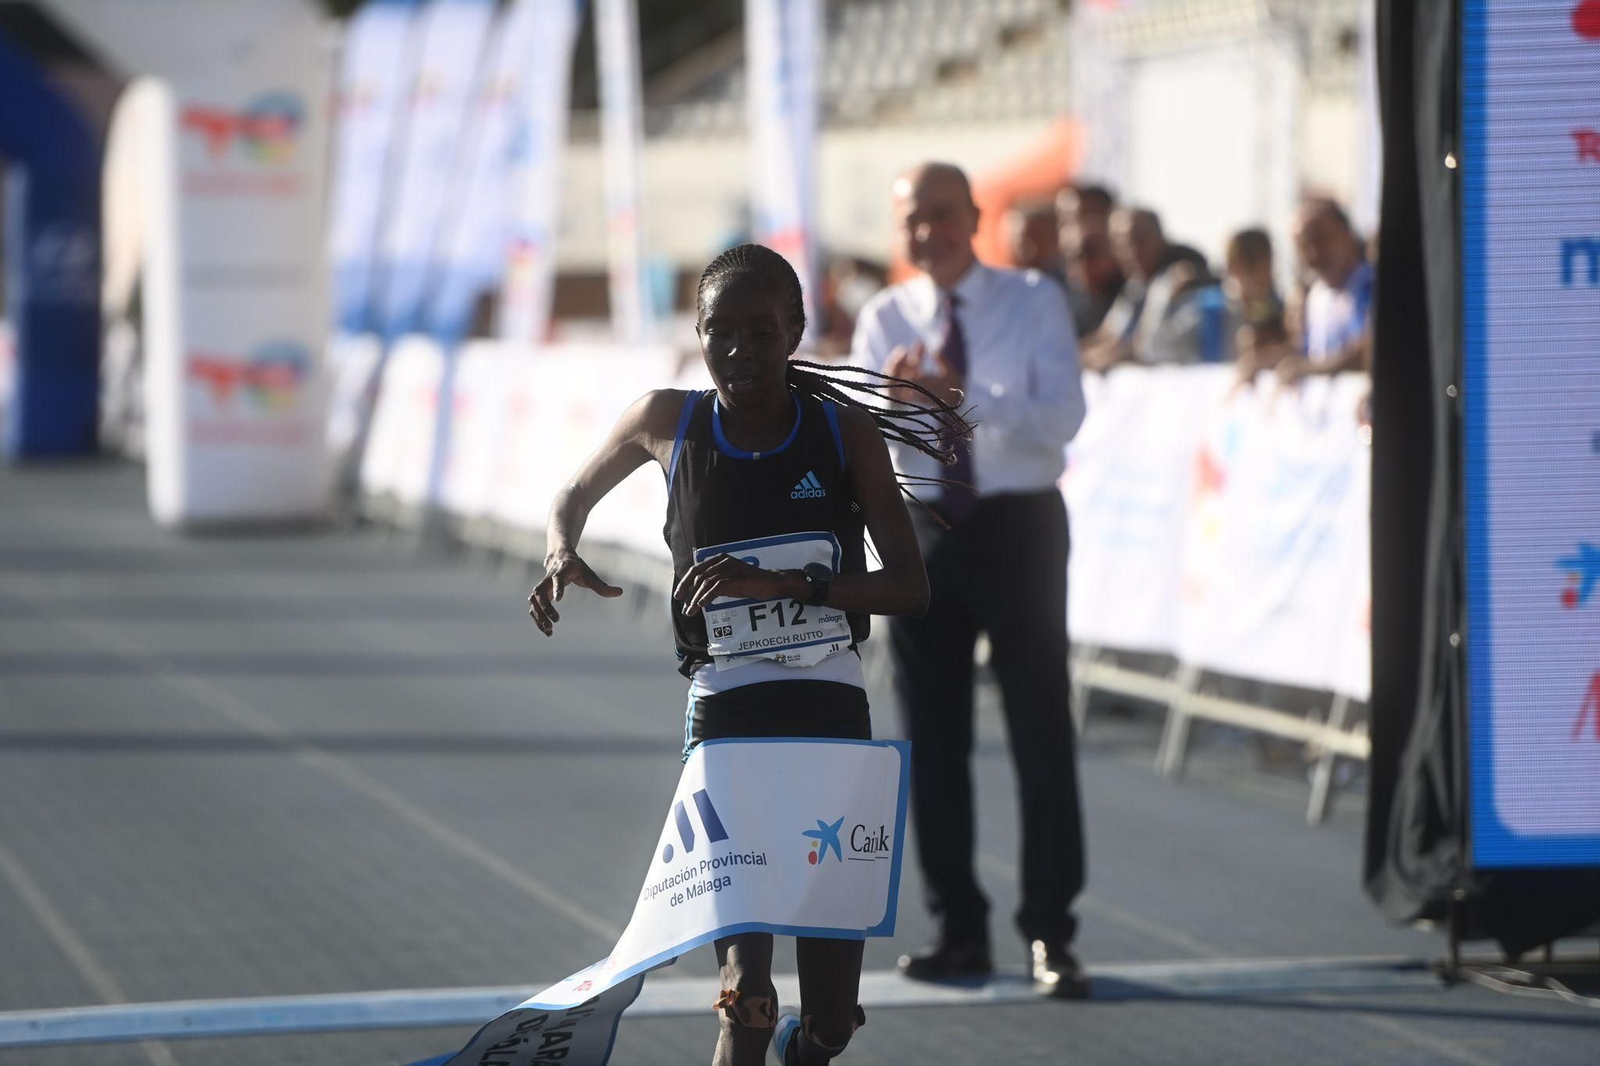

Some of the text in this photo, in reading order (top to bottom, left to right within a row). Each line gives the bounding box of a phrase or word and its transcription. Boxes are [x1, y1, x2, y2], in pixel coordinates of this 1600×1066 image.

[790, 488, 826, 499] adidas
[748, 601, 807, 632] F12
[738, 630, 824, 651] JEPKOECH RUTTO
[643, 851, 768, 901] Diputación Provincial
[670, 875, 732, 907] de Málaga
